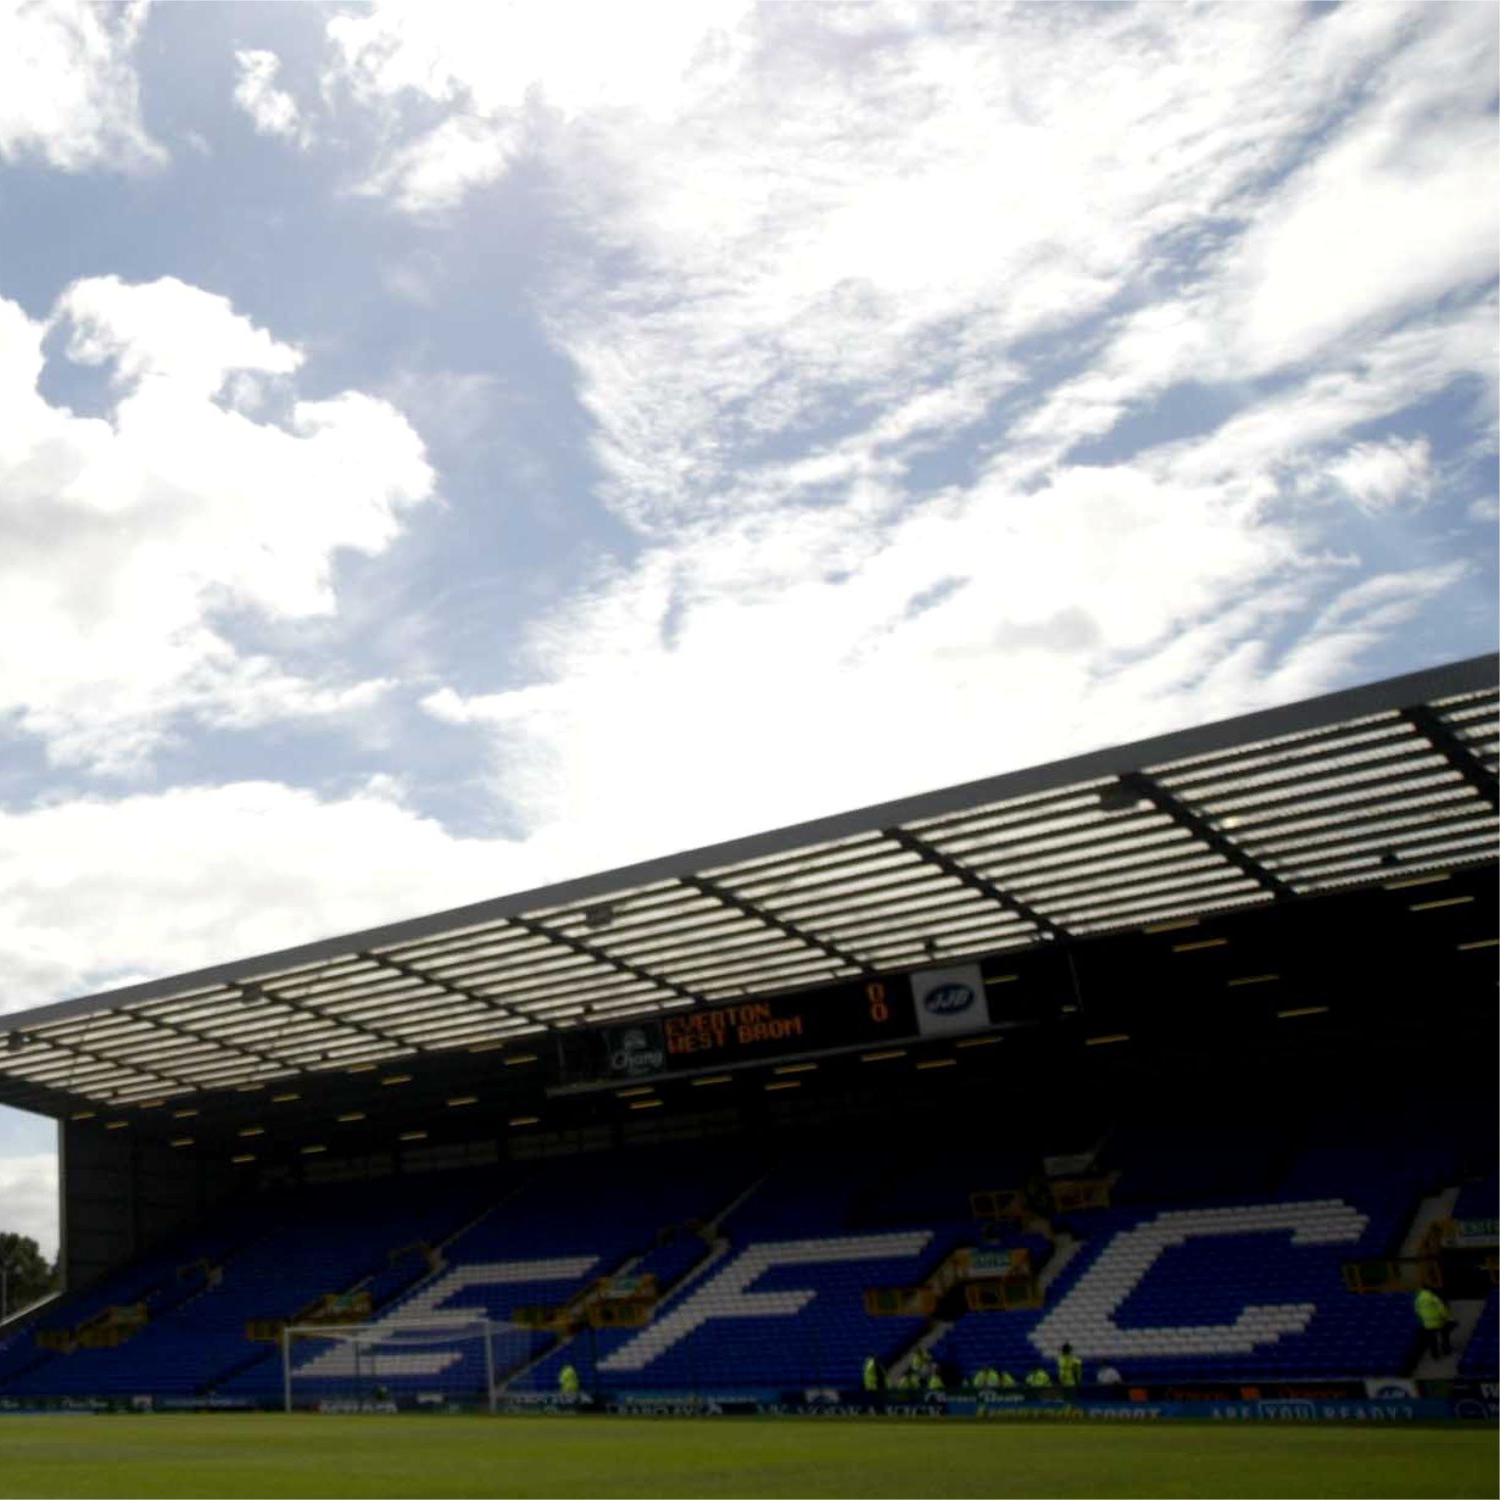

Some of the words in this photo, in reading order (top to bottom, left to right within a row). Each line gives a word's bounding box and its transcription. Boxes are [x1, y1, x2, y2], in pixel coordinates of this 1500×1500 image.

[666, 1002, 770, 1033] EVERTON
[865, 980, 887, 1001] 0
[667, 1031, 725, 1054] WEST
[738, 1016, 804, 1044] BROM
[870, 1001, 891, 1023] 0
[611, 1050, 664, 1070] Chang
[596, 1228, 935, 1373] F
[1027, 1197, 1371, 1361] C
